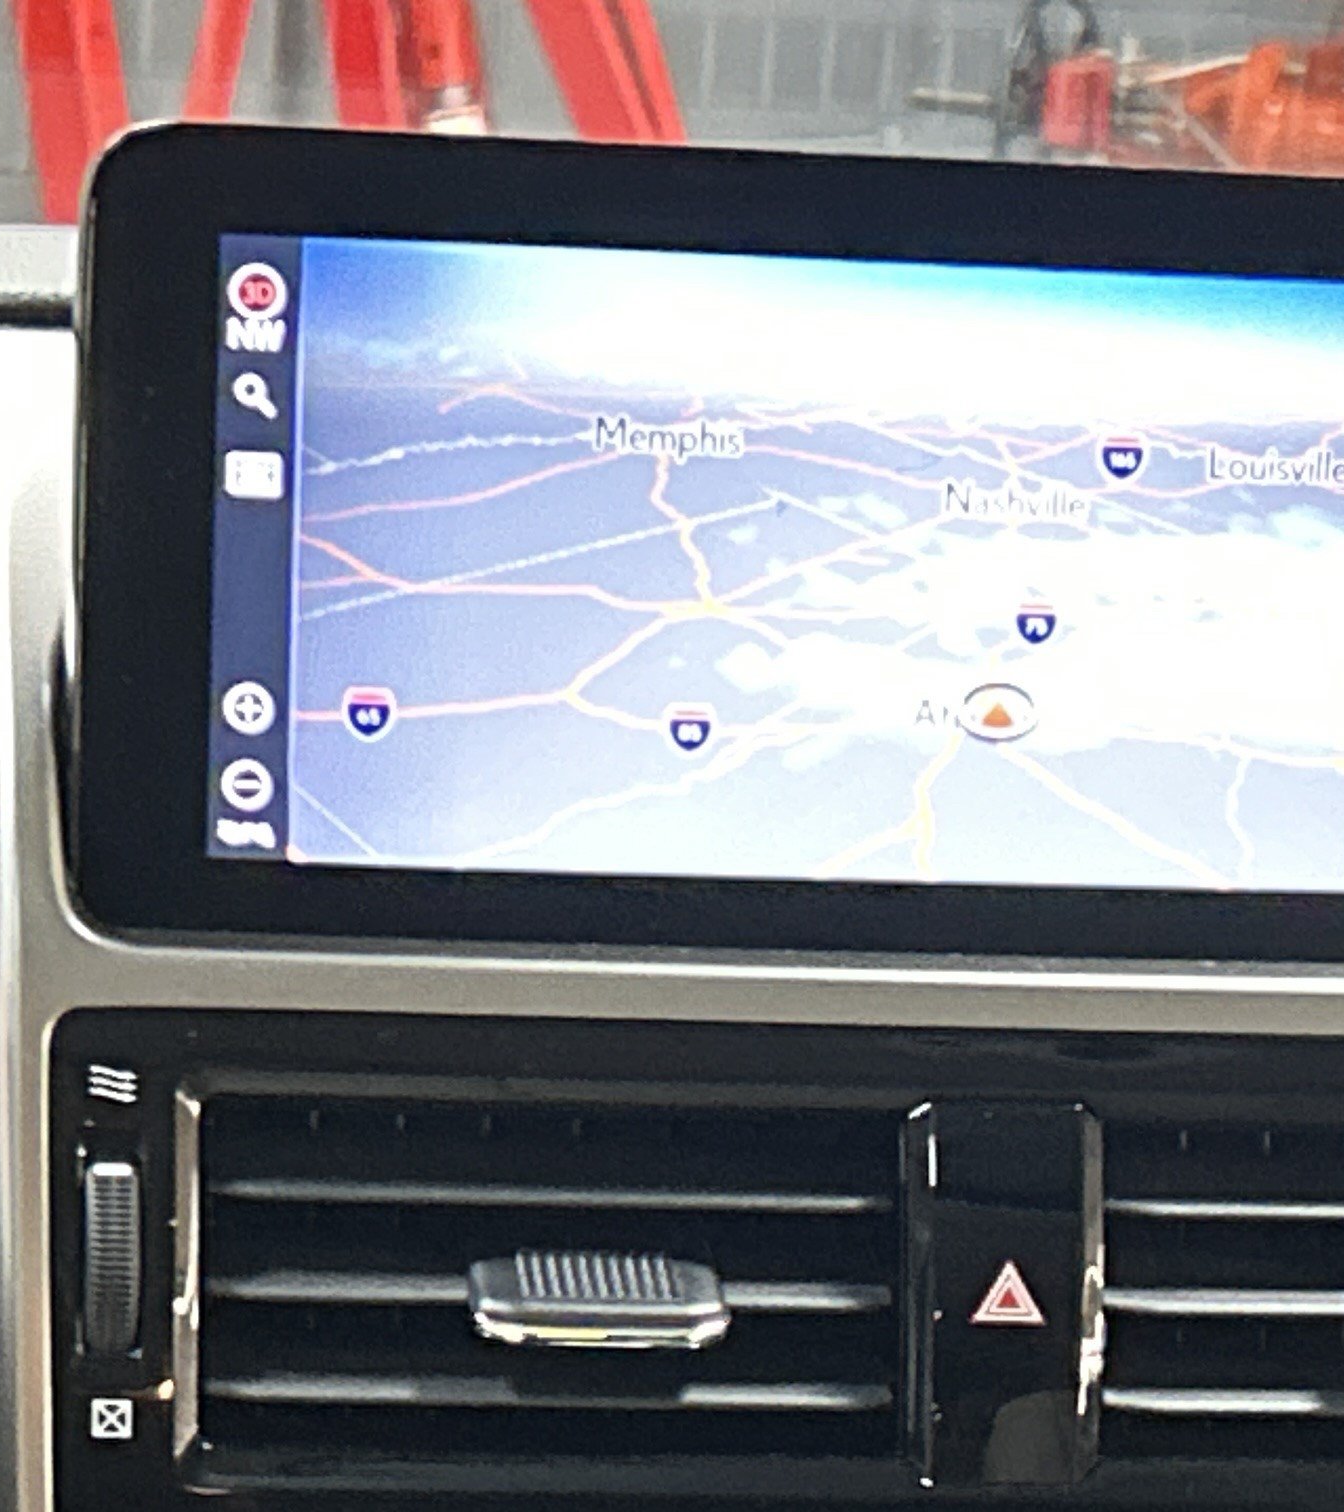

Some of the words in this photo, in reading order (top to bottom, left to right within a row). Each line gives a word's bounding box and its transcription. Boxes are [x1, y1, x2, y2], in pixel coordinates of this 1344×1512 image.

[225, 318, 285, 352] NW
[595, 416, 740, 458] Memphis
[944, 484, 1086, 522] Nashville
